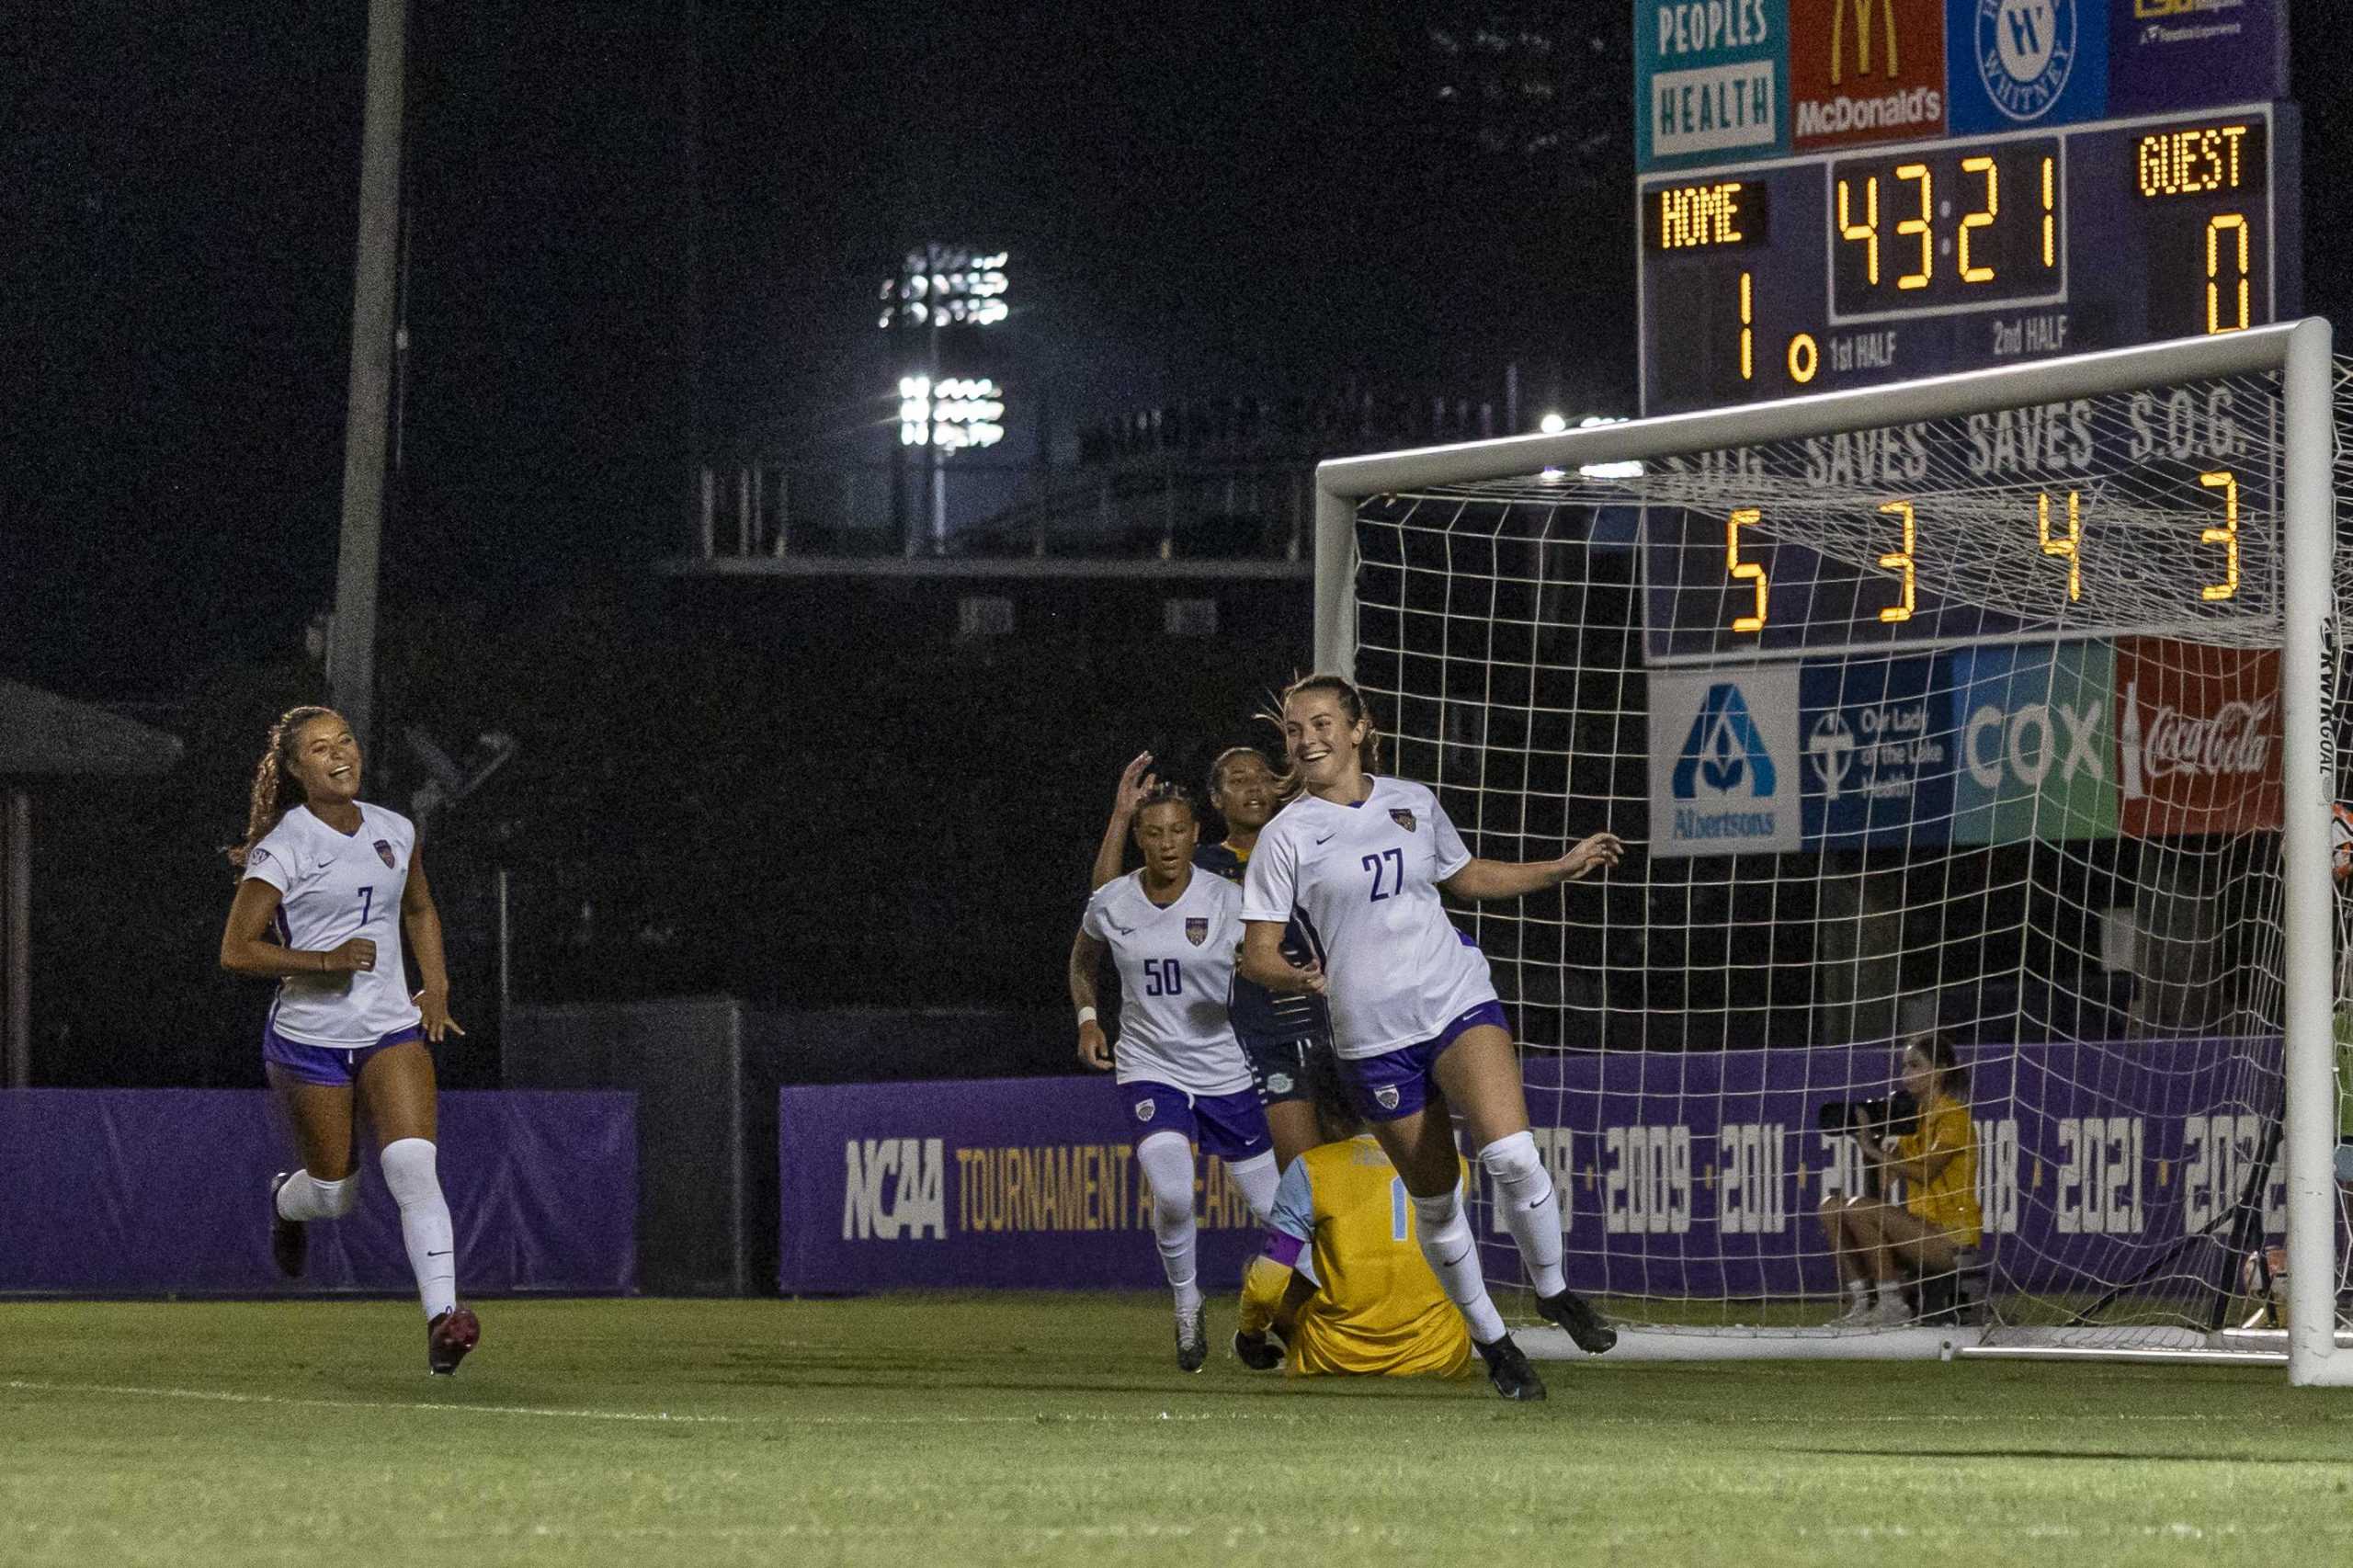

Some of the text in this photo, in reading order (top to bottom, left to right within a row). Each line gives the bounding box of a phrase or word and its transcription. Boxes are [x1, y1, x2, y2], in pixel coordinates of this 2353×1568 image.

[1660, 0, 1768, 55] PEOPLES
[1661, 77, 1768, 134] HEALTH
[1796, 88, 1940, 137] McDonald's
[2139, 125, 2247, 197] GUEST
[1661, 183, 1743, 249] HOME
[1741, 272, 1753, 380] 1
[1856, 330, 1896, 369] HALF
[2026, 315, 2067, 352] HALF
[1806, 420, 1927, 487] SAVES
[1969, 399, 2094, 476] SAVES
[1727, 507, 1768, 632] 5
[1879, 500, 1915, 623] 3
[2039, 491, 2081, 602] 4
[2200, 472, 2238, 600] 3
[358, 886, 373, 926] 7
[1361, 847, 1404, 902] 27
[1143, 959, 1182, 996] 50
[843, 1139, 947, 1240] NCAA
[956, 1144, 1132, 1231] TOURNAMENT
[1607, 1125, 1691, 1233] 2009
[1722, 1123, 1785, 1233] 2011
[2057, 1117, 2143, 1233] 2021
